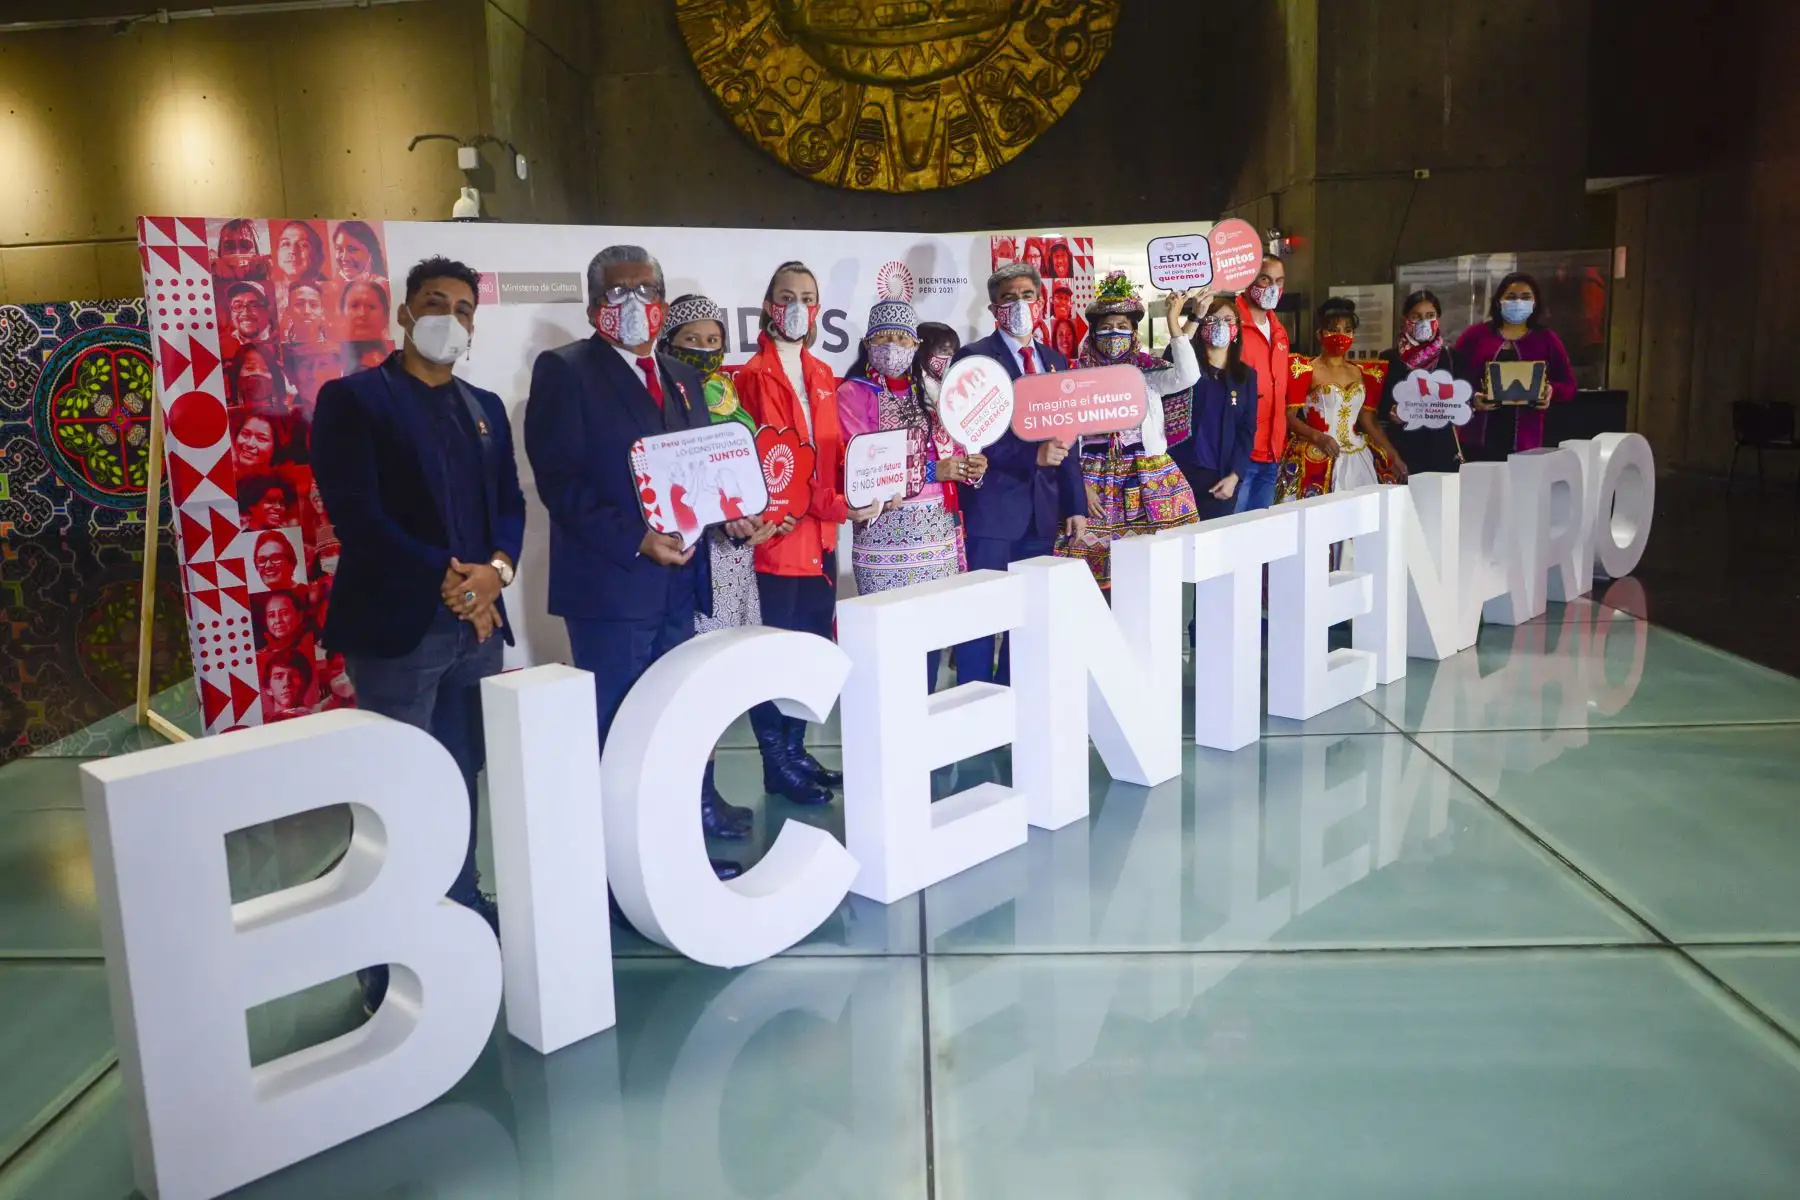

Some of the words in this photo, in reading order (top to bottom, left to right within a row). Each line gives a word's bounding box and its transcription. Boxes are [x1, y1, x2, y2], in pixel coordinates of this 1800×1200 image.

[1159, 252, 1199, 263] ESTOY
[1215, 251, 1255, 273] juntos
[1153, 261, 1207, 270] construyendo
[918, 277, 968, 285] BICENTENARIO
[1158, 273, 1205, 283] queremos
[501, 282, 539, 293] Ministerio
[540, 283, 549, 292] de
[550, 282, 578, 292] Cultura
[938, 286, 954, 294] 2021
[1028, 398, 1077, 412] Imagina
[1079, 395, 1090, 405] el
[1092, 392, 1132, 405] futuro
[1430, 401, 1462, 409] millones
[970, 399, 1010, 442] QUEREMOS
[1024, 416, 1037, 430] SI
[1041, 412, 1074, 427] NOS
[1077, 404, 1139, 423] UNIMOS
[709, 447, 750, 463] JUNTOS
[884, 462, 902, 472] futuro
[851, 480, 859, 492] SI
[860, 477, 875, 490] NOS
[876, 473, 904, 487] UNIMOS
[80, 431, 1655, 1200] BICENTENARIO
